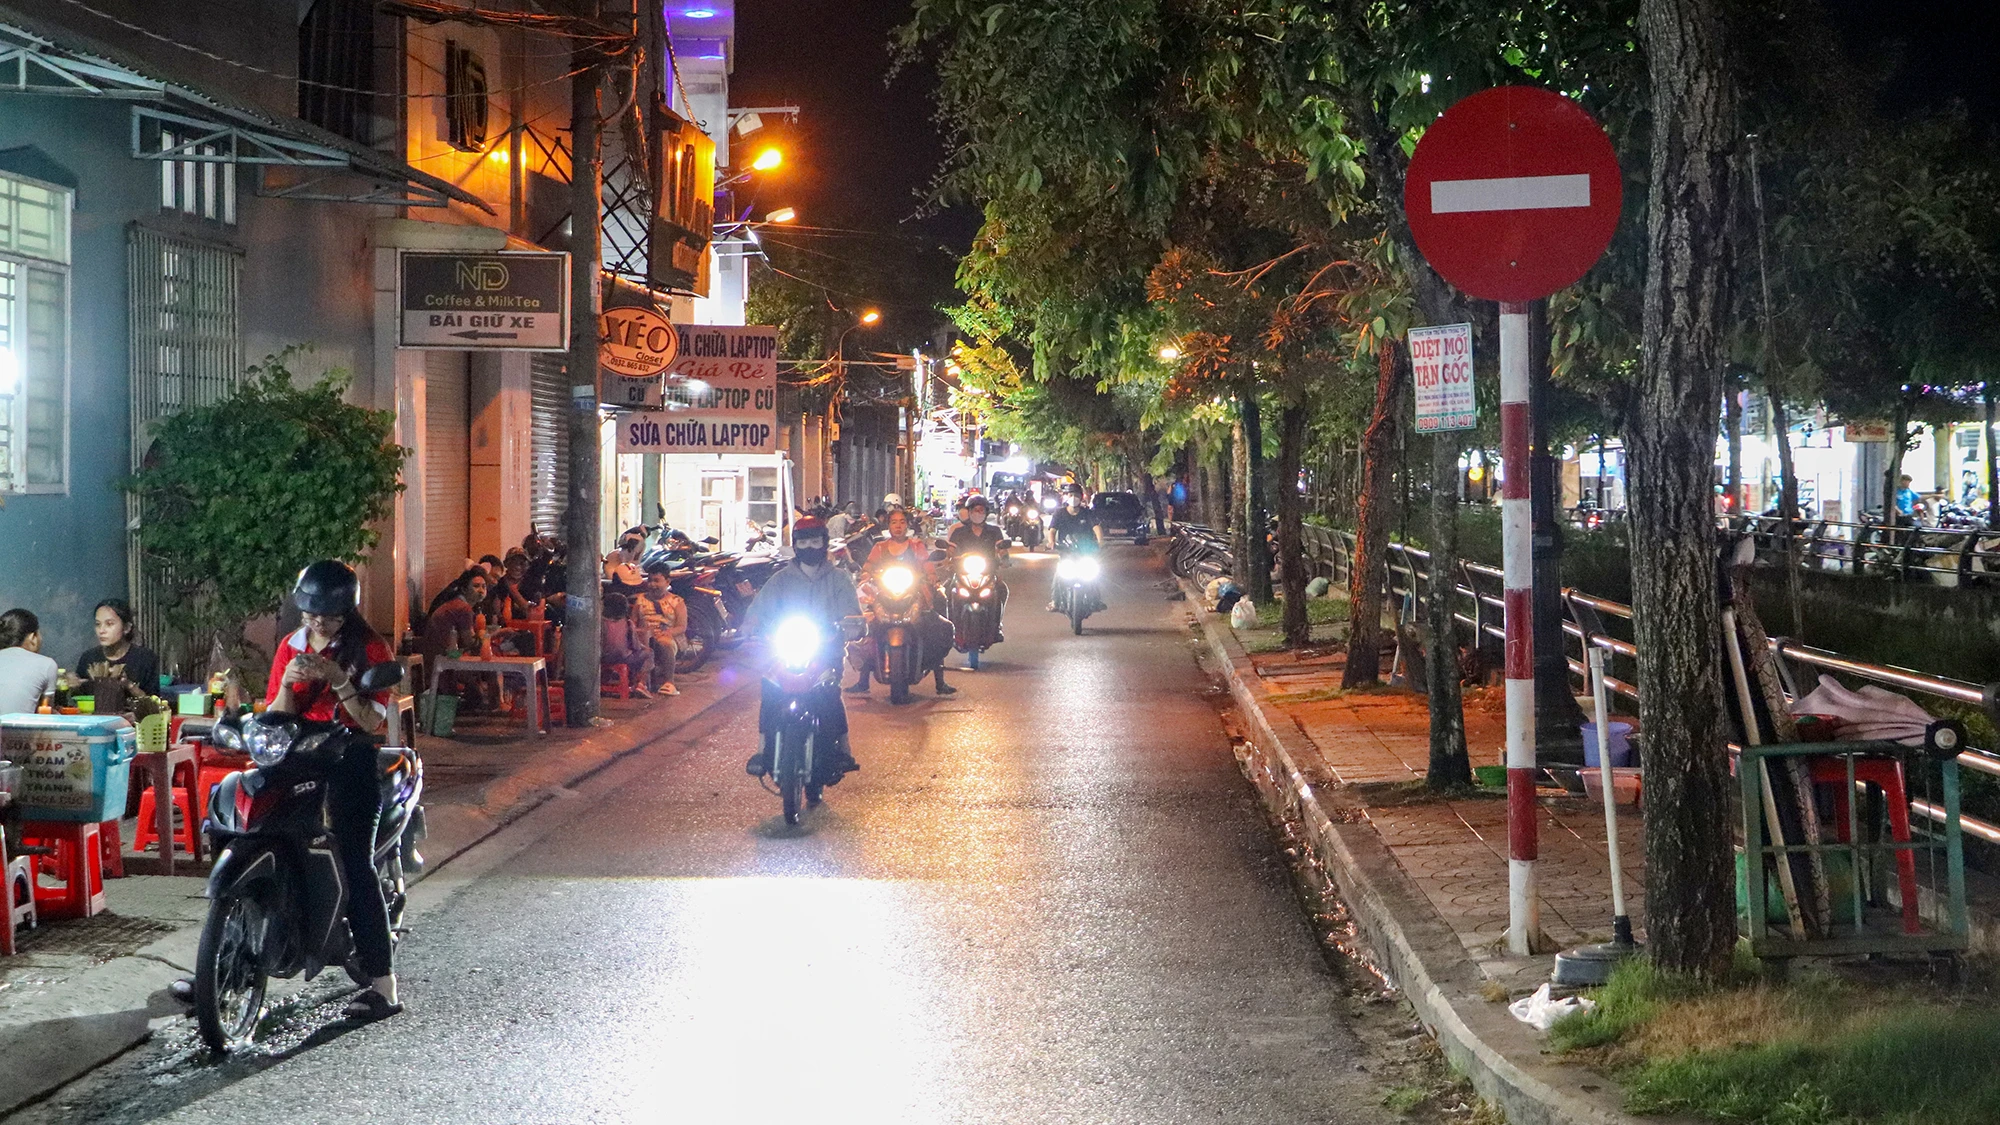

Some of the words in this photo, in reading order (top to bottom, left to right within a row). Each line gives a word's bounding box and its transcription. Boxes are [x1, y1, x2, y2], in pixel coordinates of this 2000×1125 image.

[455, 261, 510, 291] ND
[425, 294, 471, 307] Coffee
[474, 296, 486, 307] &
[429, 313, 463, 327] BÃI
[469, 313, 506, 328] GIỮ
[510, 316, 536, 329] XE
[678, 325, 691, 357] ỬA
[695, 330, 727, 358] CHỮA
[730, 335, 776, 359] LAPTOP
[1412, 336, 1441, 360] DIỆT
[1444, 332, 1469, 356] MỐI
[635, 351, 664, 365] Closet
[675, 360, 723, 380] Giá
[728, 361, 768, 379] Rẻ
[1415, 361, 1439, 389] TẬN
[1442, 355, 1469, 385] GỐC
[755, 385, 774, 411] CŨ
[629, 415, 661, 447] SỬA
[665, 418, 707, 447] CHỮA
[712, 423, 770, 447] LAPTOP
[1440, 415, 1456, 429] 113
[1458, 414, 1473, 427] 407
